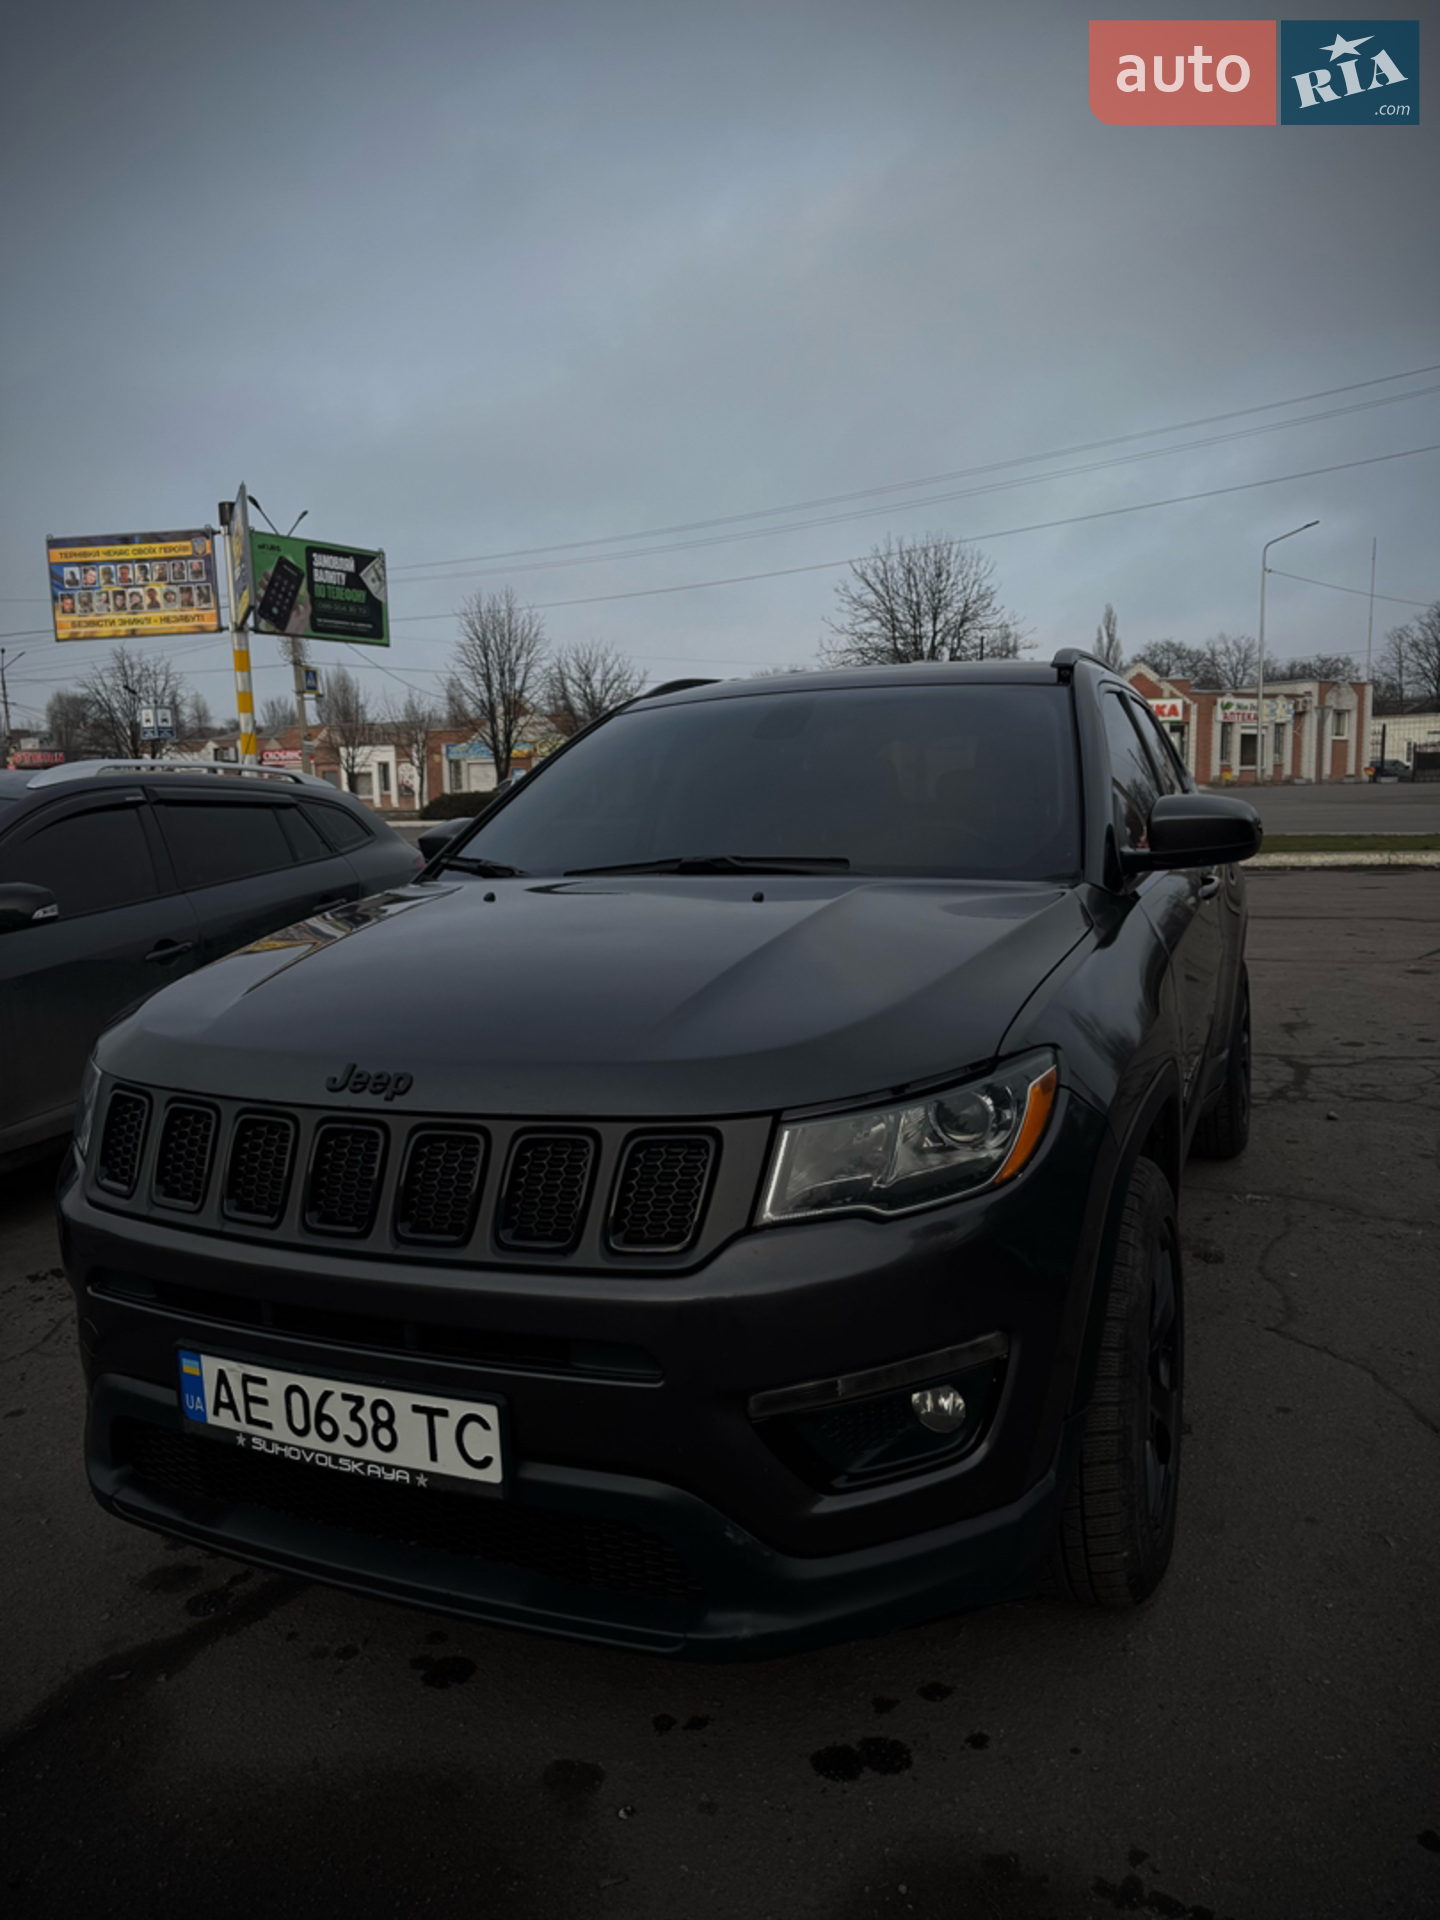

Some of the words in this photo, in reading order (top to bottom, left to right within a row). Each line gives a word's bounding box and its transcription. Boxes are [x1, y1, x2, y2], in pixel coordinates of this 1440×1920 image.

[131, 545, 157, 555] СВОЇХ
[312, 568, 347, 586] ВАЛЮТУ
[313, 583, 326, 599] ПО
[326, 585, 367, 603] ТЕЛЕФОНУ
[325, 1063, 414, 1102] Jeep
[185, 1393, 205, 1413] UA
[212, 1368, 273, 1431] AE
[284, 1384, 398, 1453] 0638
[411, 1403, 494, 1470] TC
[251, 1437, 411, 1484] SUHOVOLSKAYA
